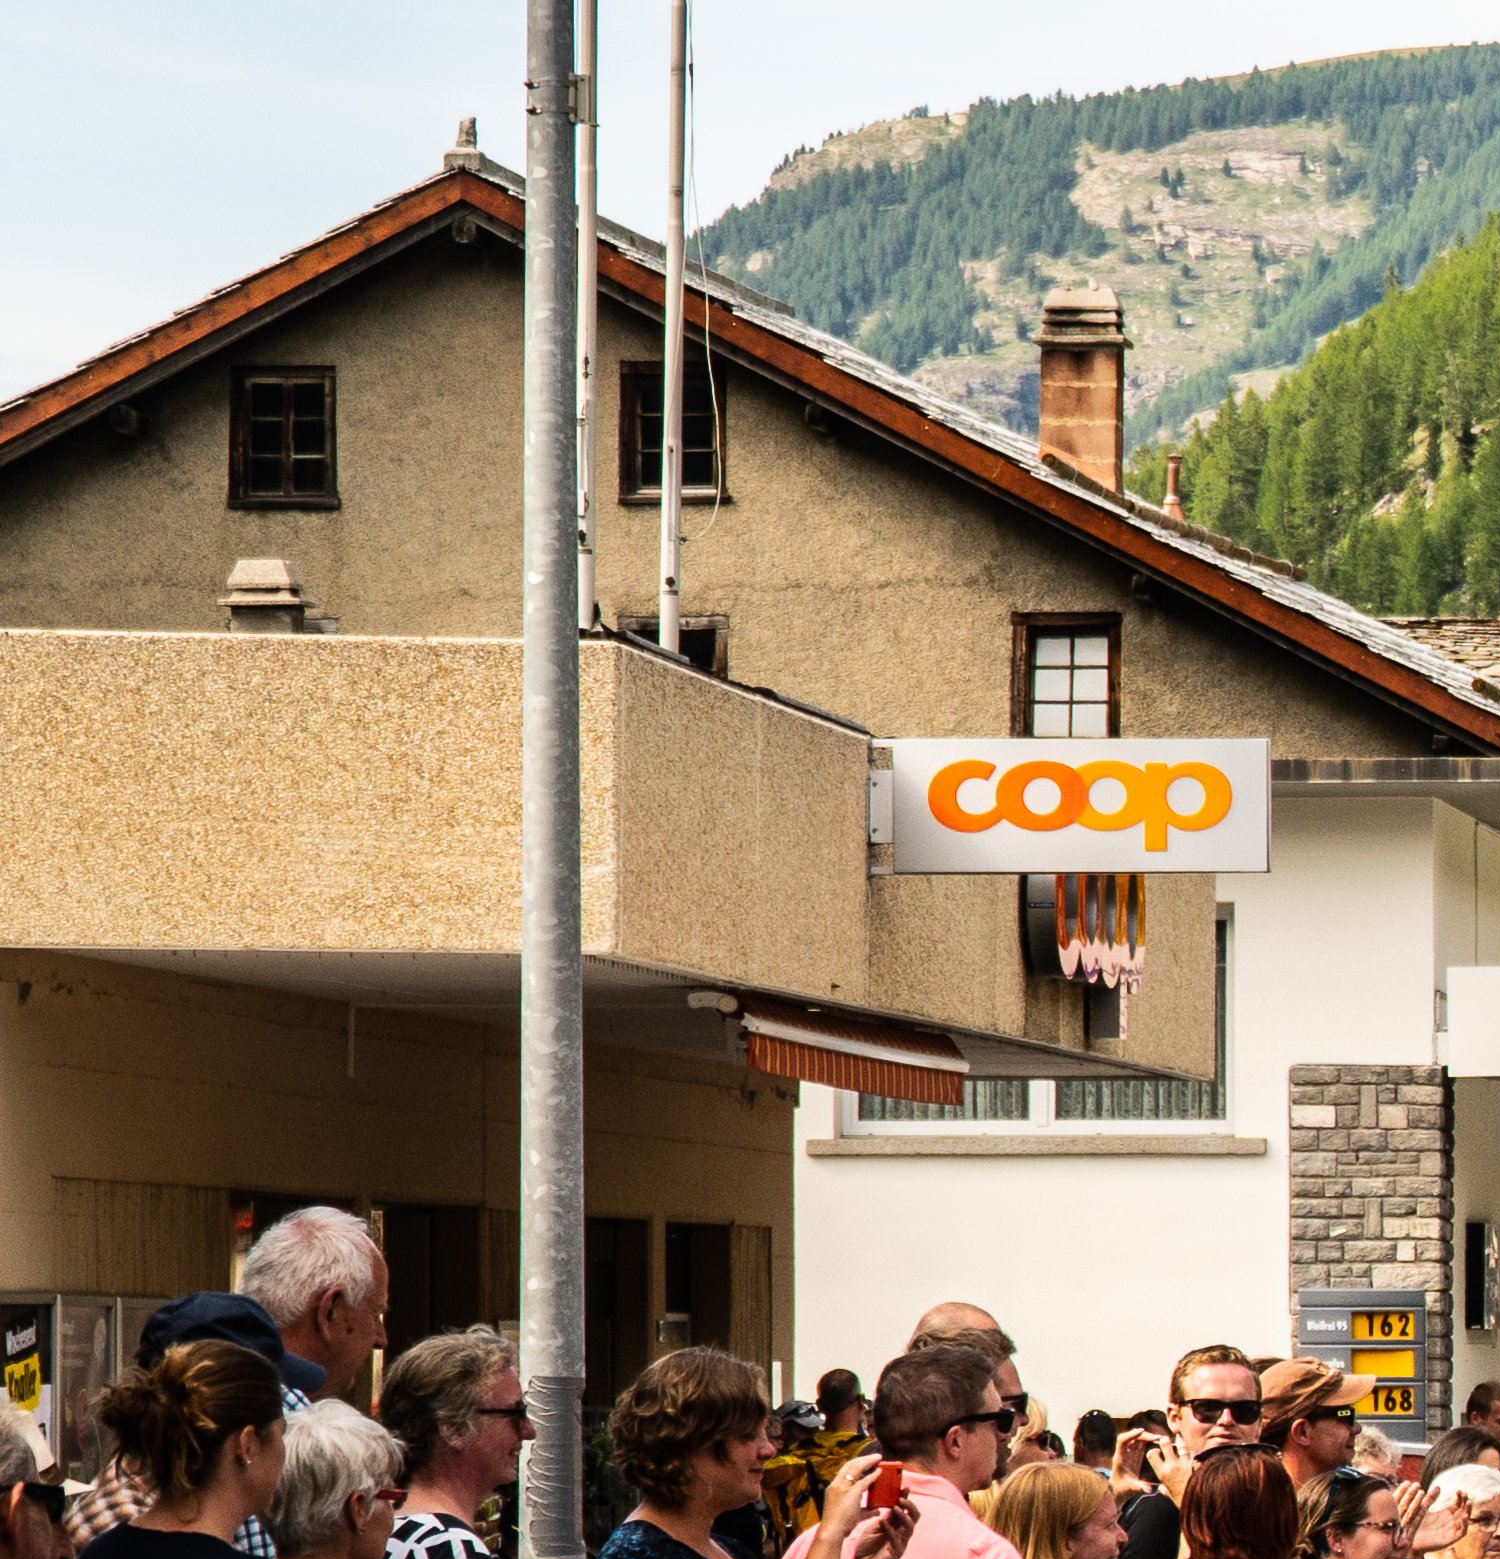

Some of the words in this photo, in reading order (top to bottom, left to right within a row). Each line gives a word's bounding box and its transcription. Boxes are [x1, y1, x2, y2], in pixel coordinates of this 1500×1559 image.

[928, 759, 1232, 852] coop
[1365, 1313, 1410, 1337] 162
[1371, 1389, 1413, 1412] 168
